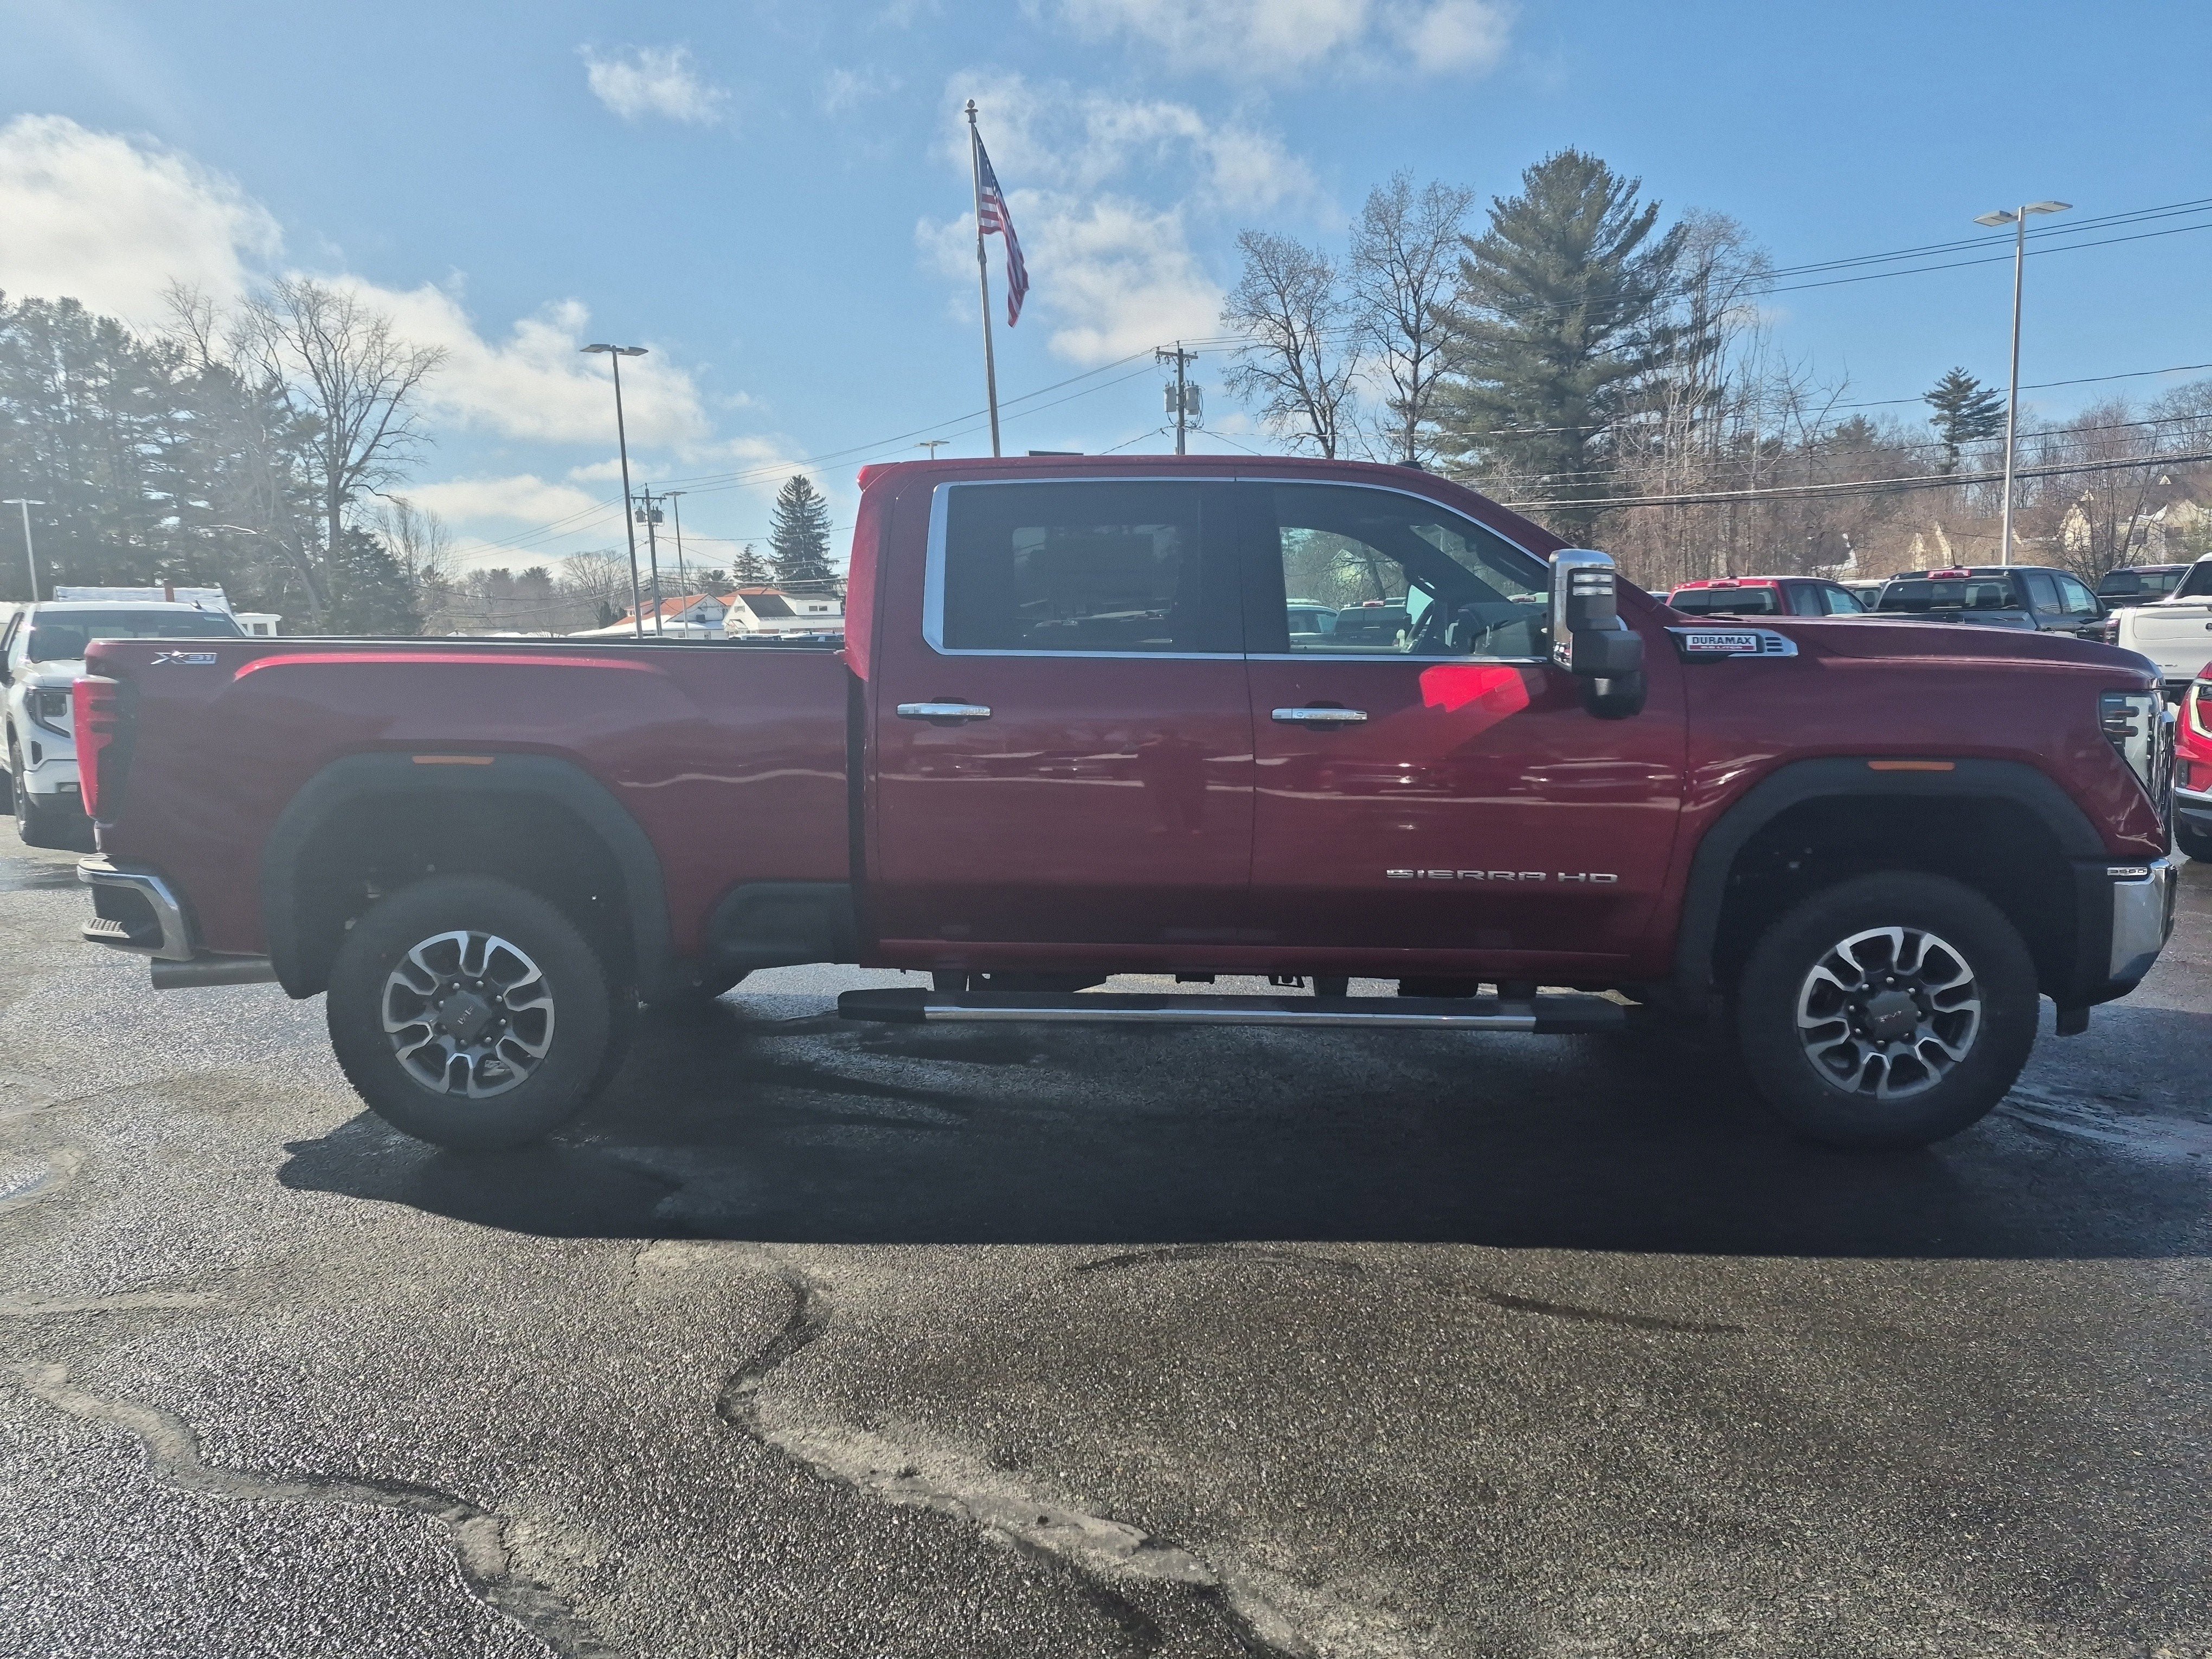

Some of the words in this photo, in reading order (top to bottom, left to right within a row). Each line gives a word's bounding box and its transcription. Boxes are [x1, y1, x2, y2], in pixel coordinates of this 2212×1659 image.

[1692, 636, 1752, 645] DURAMAX
[150, 650, 218, 665] X31
[1386, 869, 1547, 881] SIERRA
[1558, 872, 1619, 883] HD
